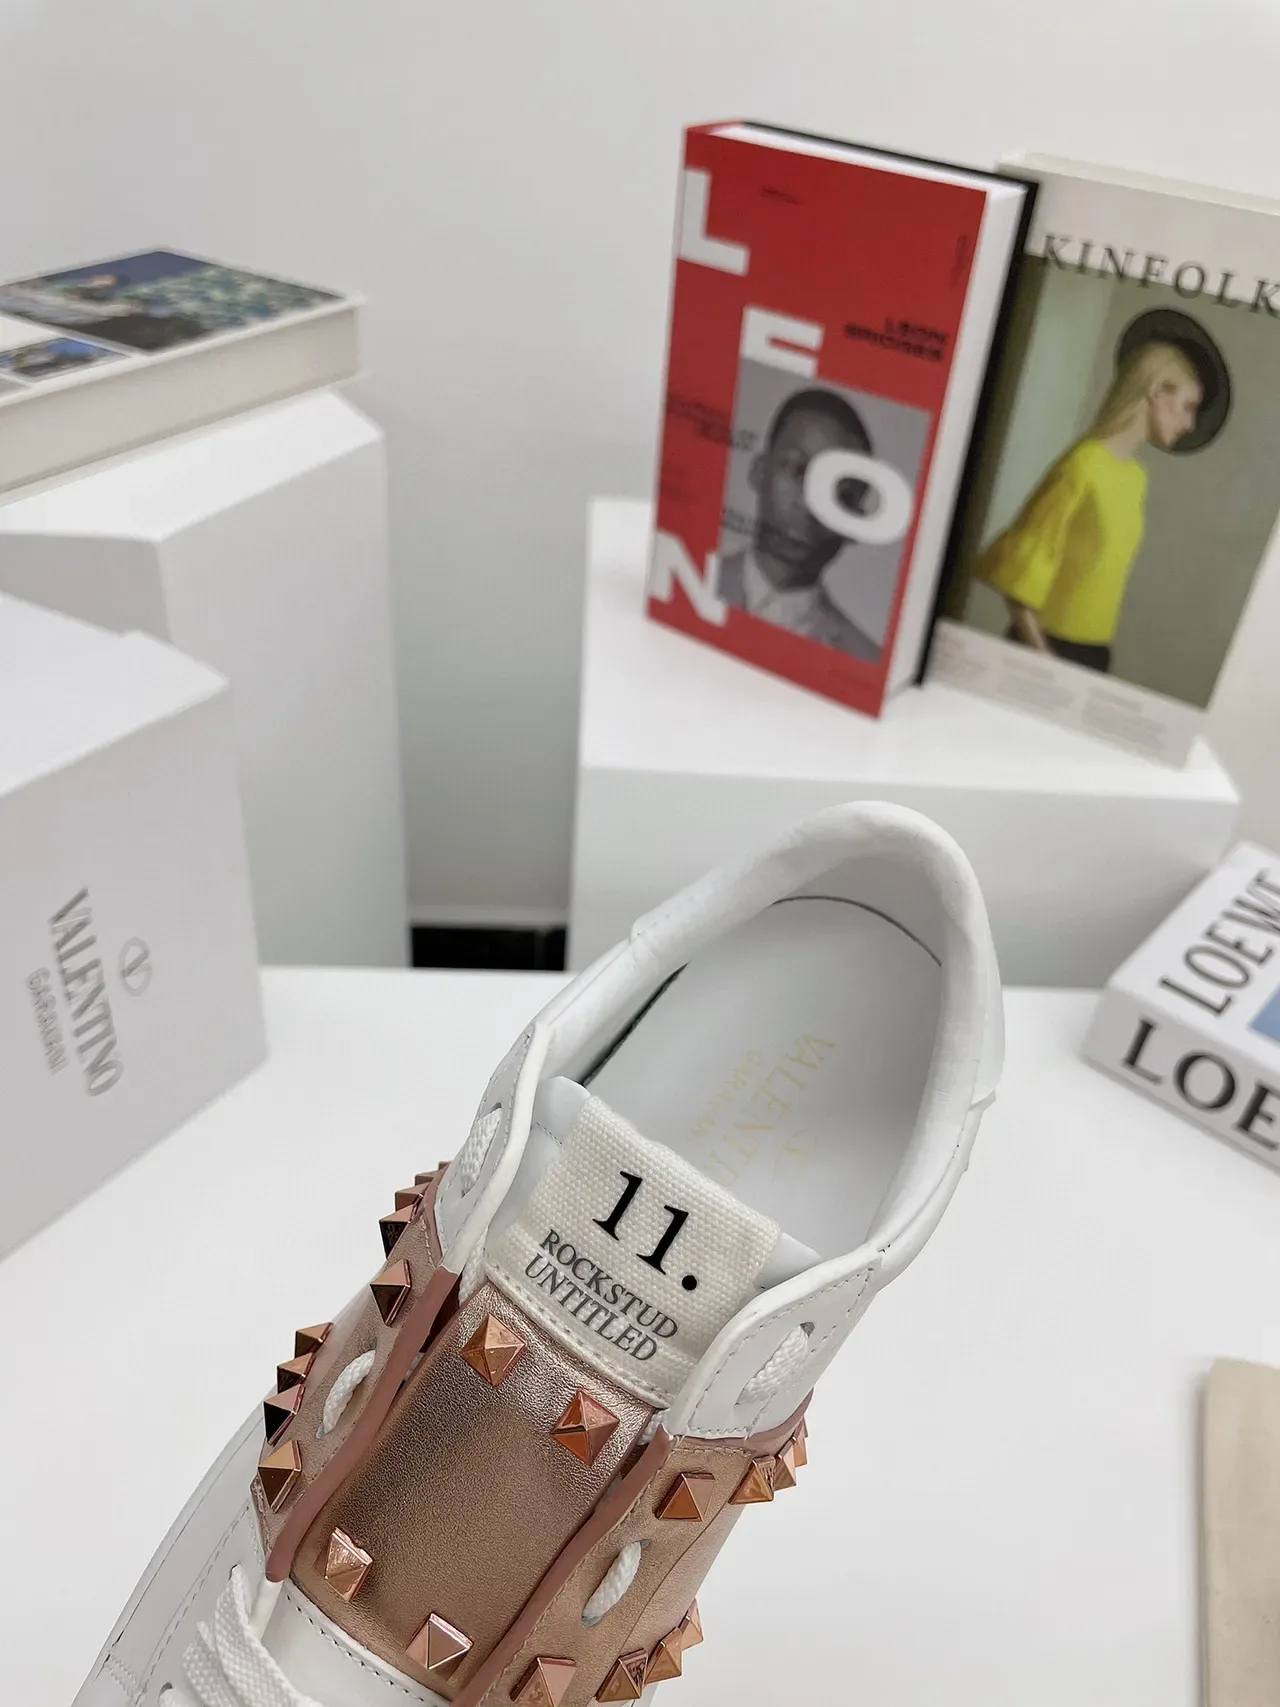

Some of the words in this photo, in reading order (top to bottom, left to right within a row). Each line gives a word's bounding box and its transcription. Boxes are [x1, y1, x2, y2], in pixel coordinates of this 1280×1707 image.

[1041, 234, 1280, 318] KINFOLK
[47, 886, 124, 1096] VALENTINO
[1121, 1015, 1280, 1151] LOE
[539, 1229, 678, 1338] ROCKSTUD
[592, 1170, 697, 1291] 11.
[524, 1253, 658, 1361] UNTITLED
